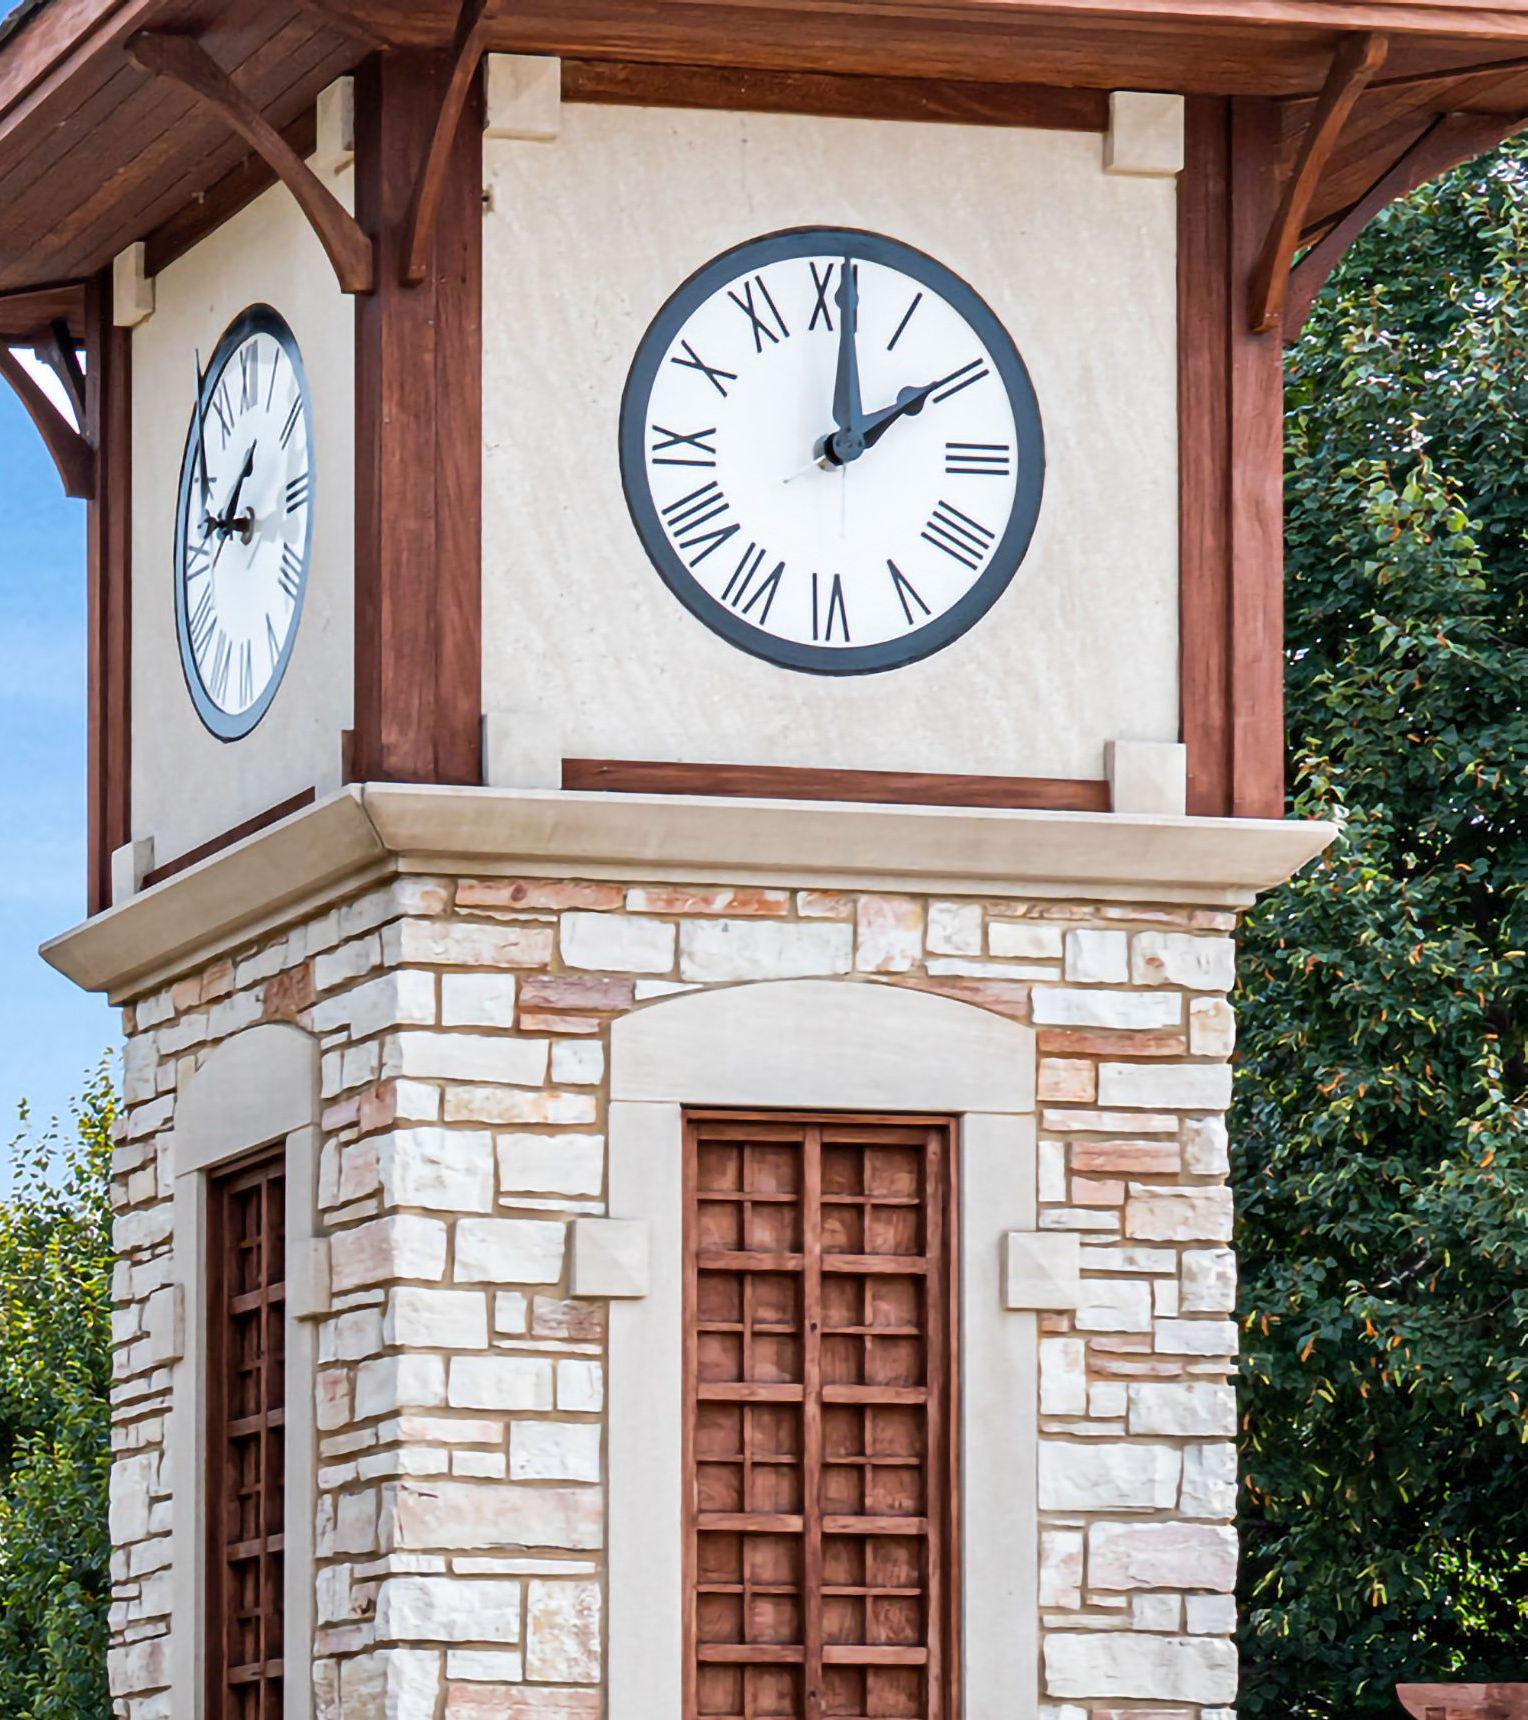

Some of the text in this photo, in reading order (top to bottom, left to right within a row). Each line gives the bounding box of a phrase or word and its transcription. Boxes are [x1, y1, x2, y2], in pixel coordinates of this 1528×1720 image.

[727, 275, 790, 353] XI
[886, 292, 923, 351] I
[670, 339, 738, 398] X
[931, 357, 990, 404] II
[651, 424, 717, 466] IX
[945, 442, 1010, 476] III
[661, 480, 741, 568] VIII
[920, 499, 996, 571] IIII
[721, 541, 786, 626] VII
[812, 572, 851, 643] VI
[886, 558, 932, 626] V
